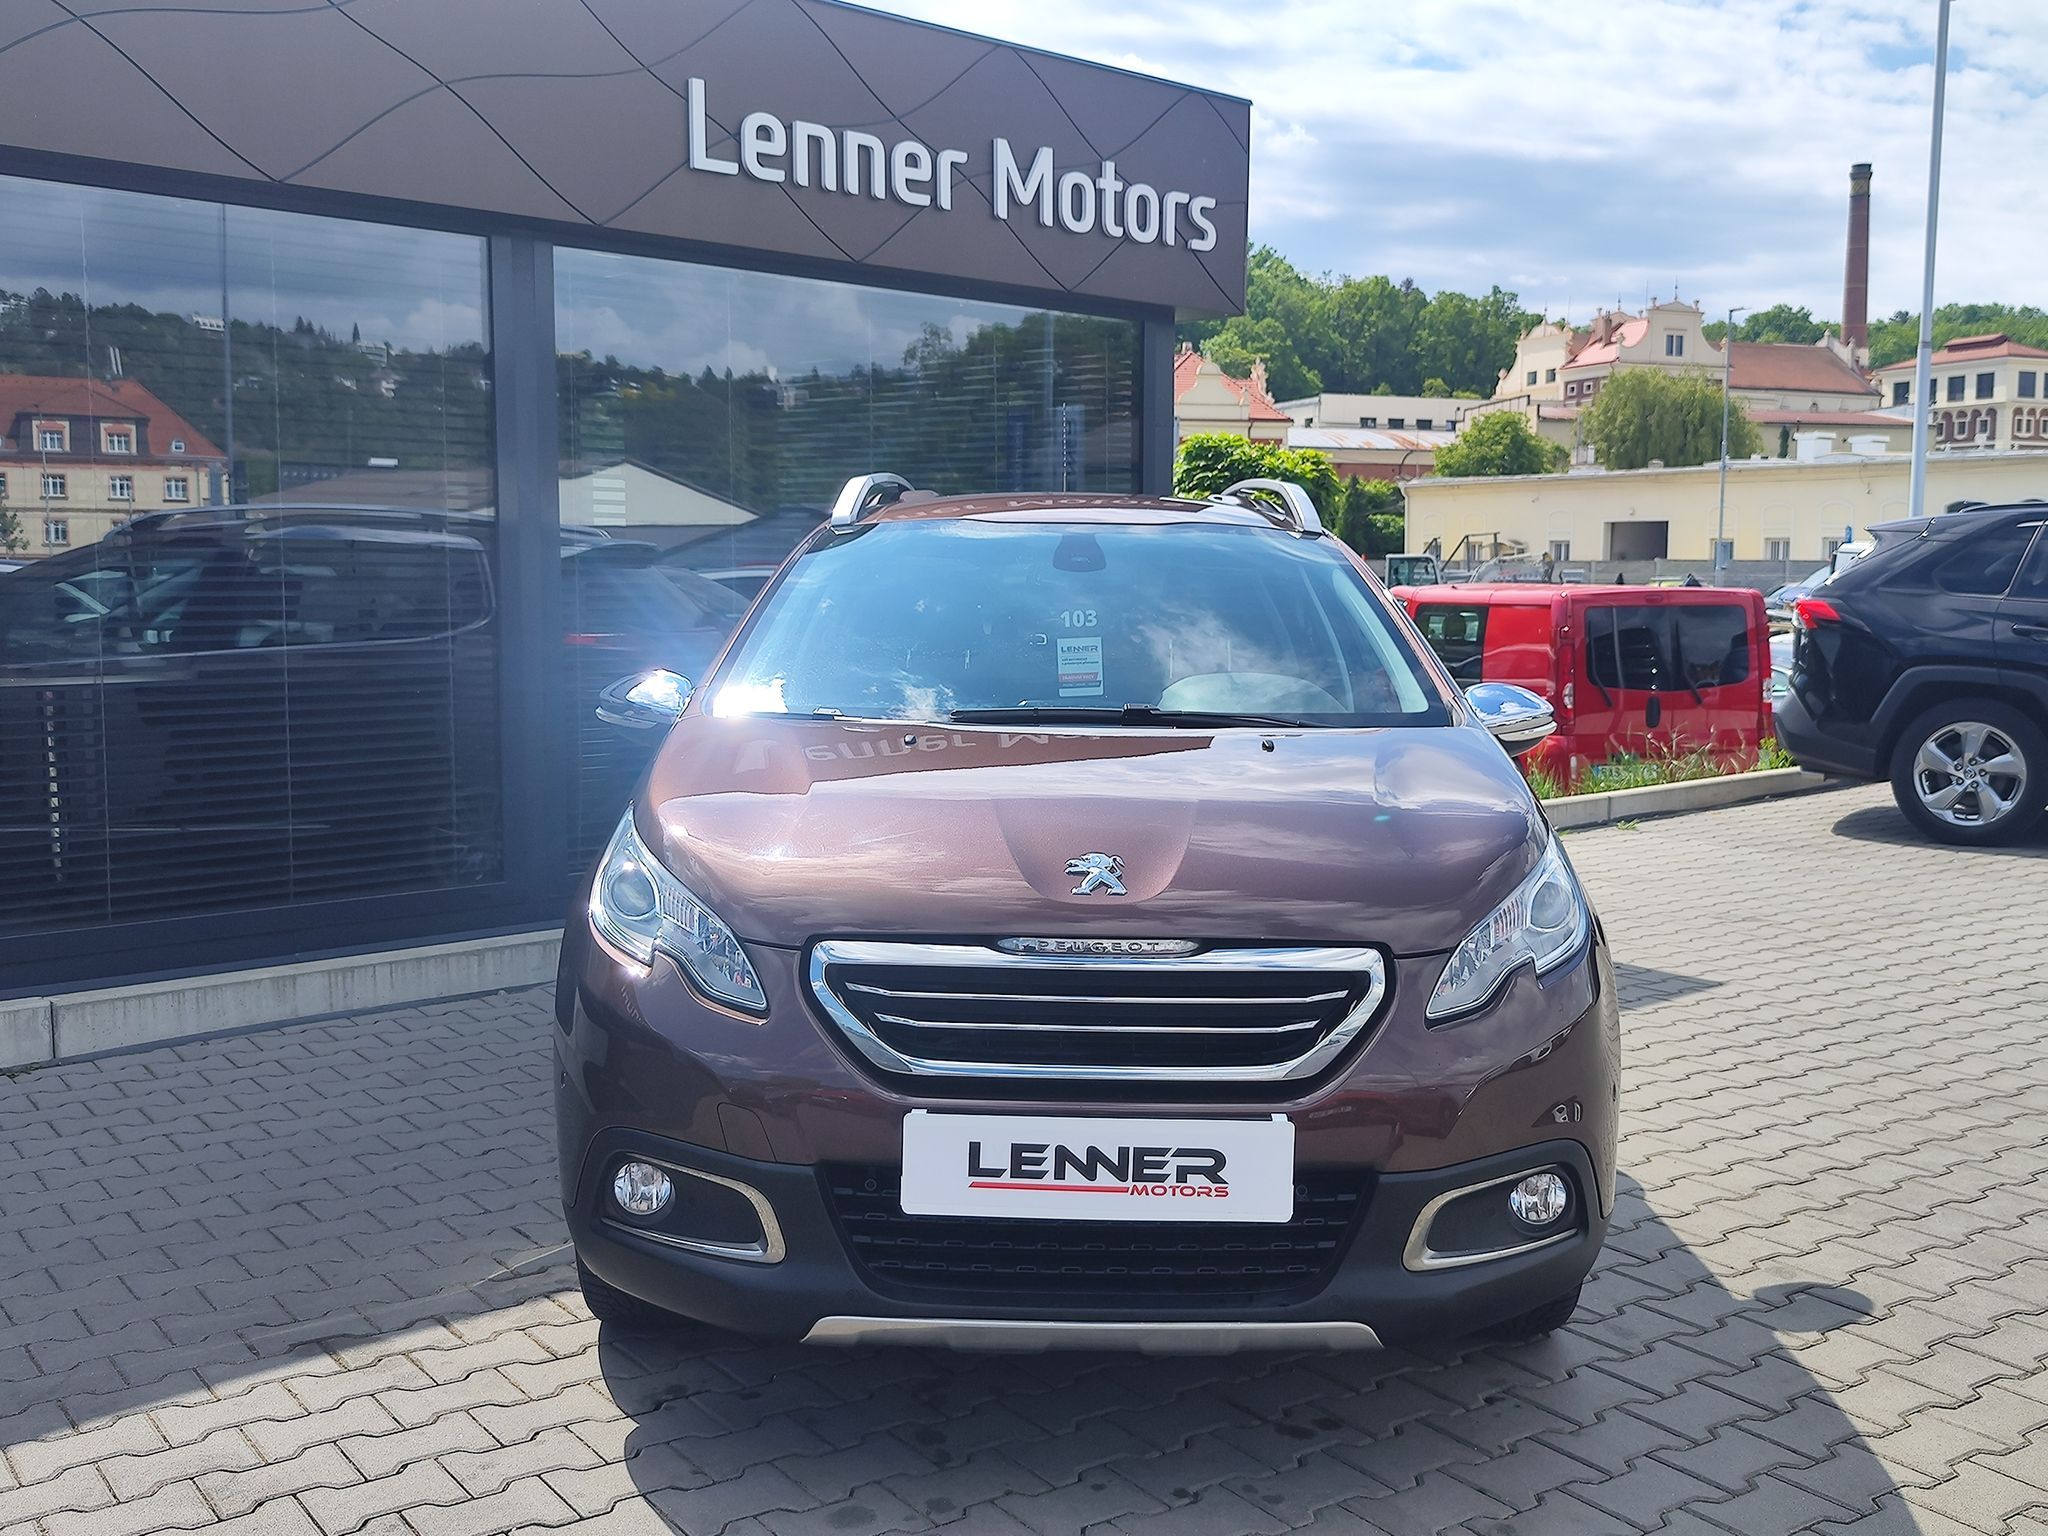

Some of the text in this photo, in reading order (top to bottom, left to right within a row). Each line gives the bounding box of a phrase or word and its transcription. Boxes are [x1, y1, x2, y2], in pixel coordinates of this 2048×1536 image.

[687, 77, 1217, 252] Lenner Motors
[1060, 609, 1098, 627] 103
[1061, 645, 1099, 654] LENNER
[1037, 940, 1160, 953] PEUGEOT
[967, 1141, 1230, 1185] LENNER
[1127, 1183, 1230, 1198] MOTORS
